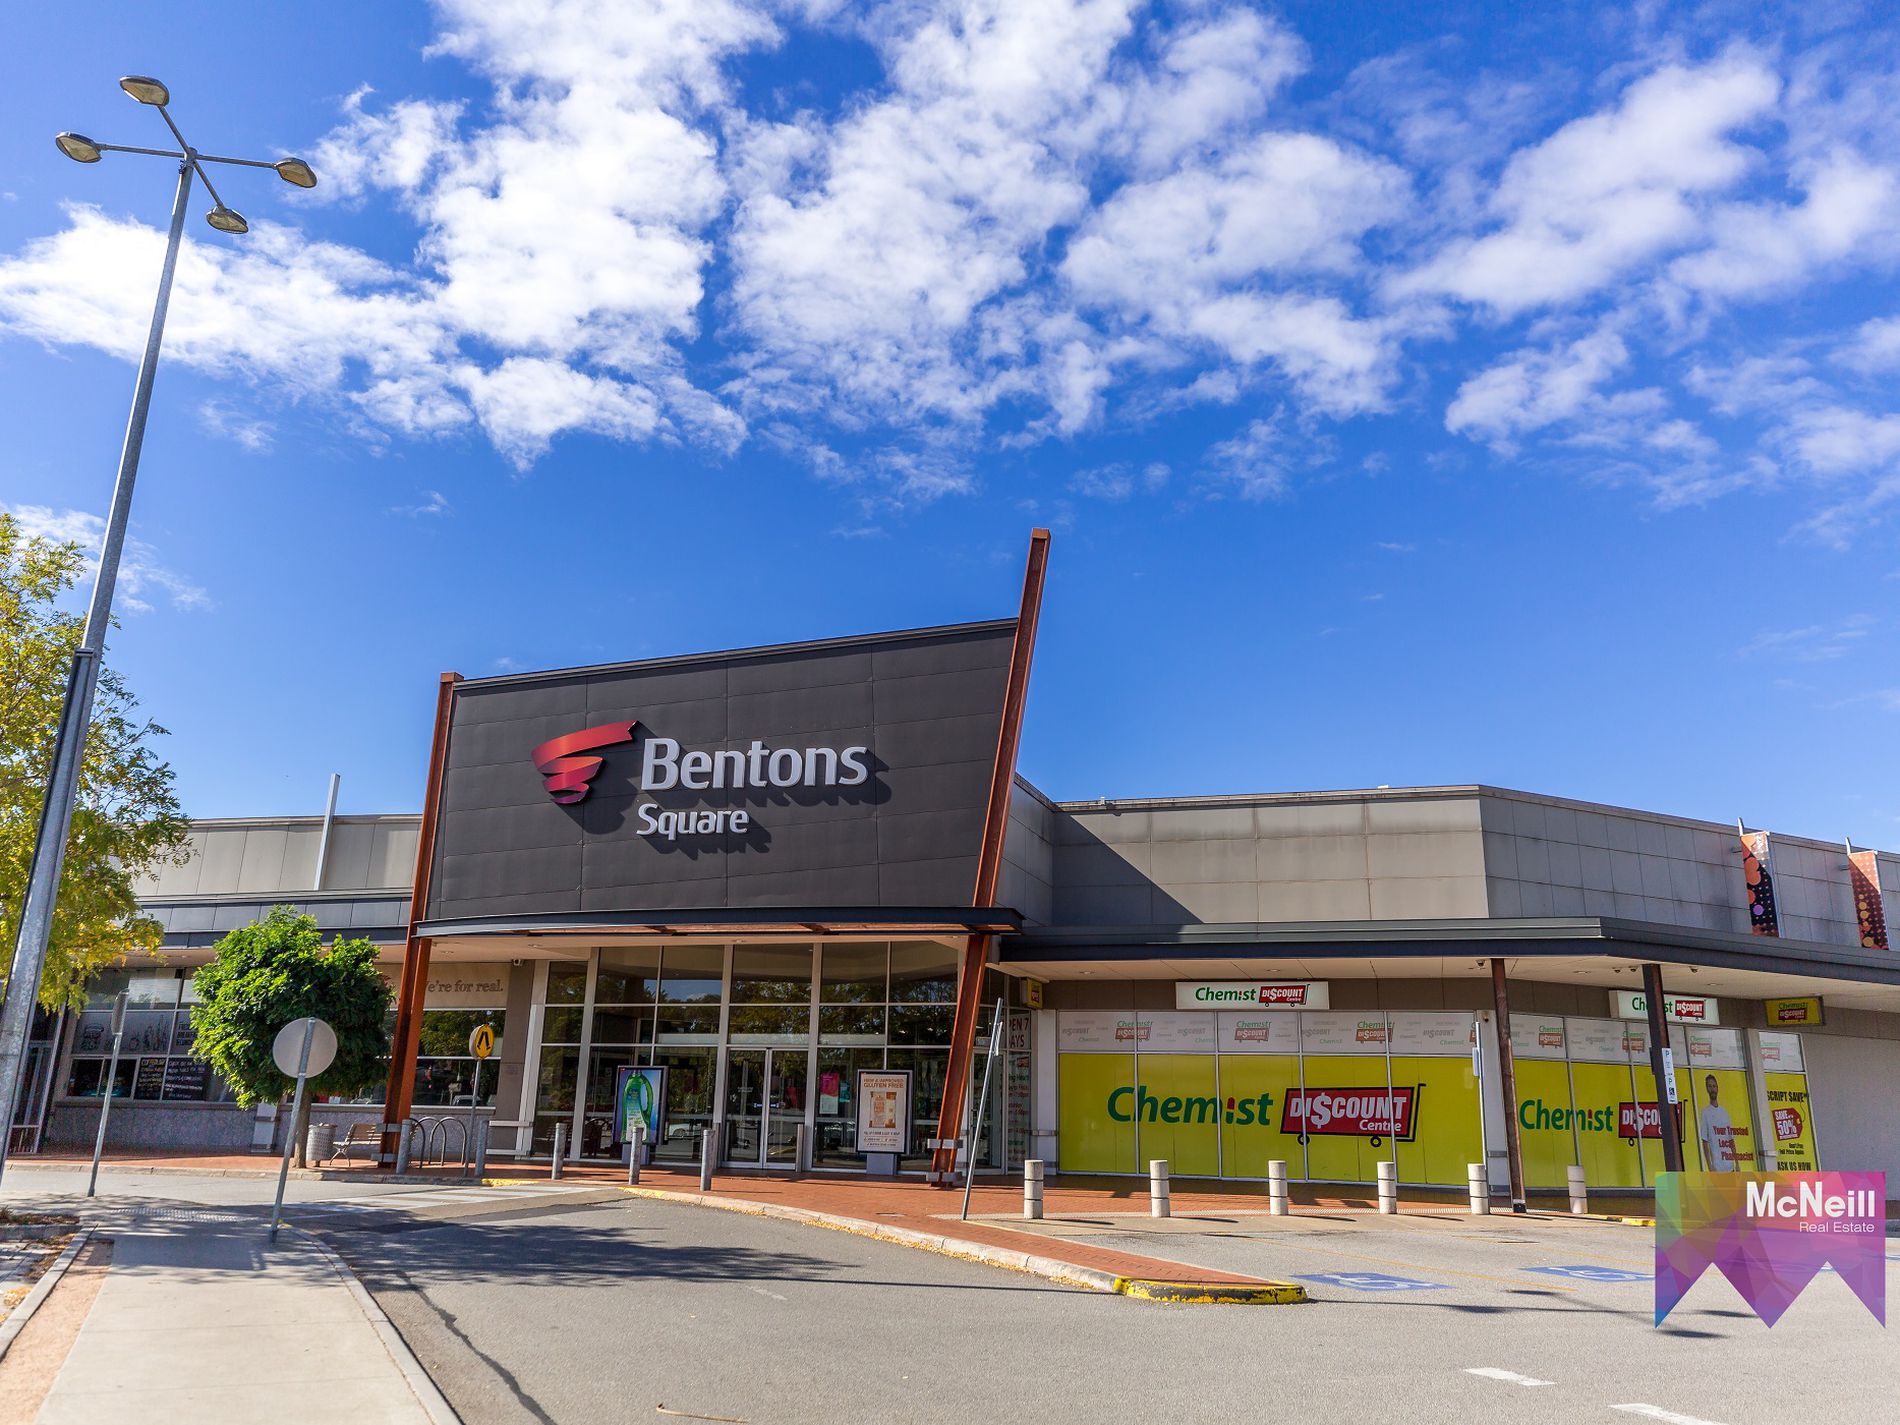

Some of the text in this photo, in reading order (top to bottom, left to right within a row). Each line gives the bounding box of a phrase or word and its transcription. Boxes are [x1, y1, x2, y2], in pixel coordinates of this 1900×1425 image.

[641, 738, 868, 791] Bentons
[636, 803, 750, 841] Square
[455, 980, 473, 992] for
[476, 979, 504, 992] real.
[1195, 986, 1257, 1001] Chemist
[1107, 1085, 1273, 1126] Chemist
[1520, 1098, 1613, 1132] Chemist
[1359, 1118, 1402, 1133] Centre
[1727, 1126, 1748, 1136] Trusted
[1776, 1119, 1797, 1136] 50%
[1777, 1161, 1788, 1171] ASK
[1789, 1161, 1798, 1171] US
